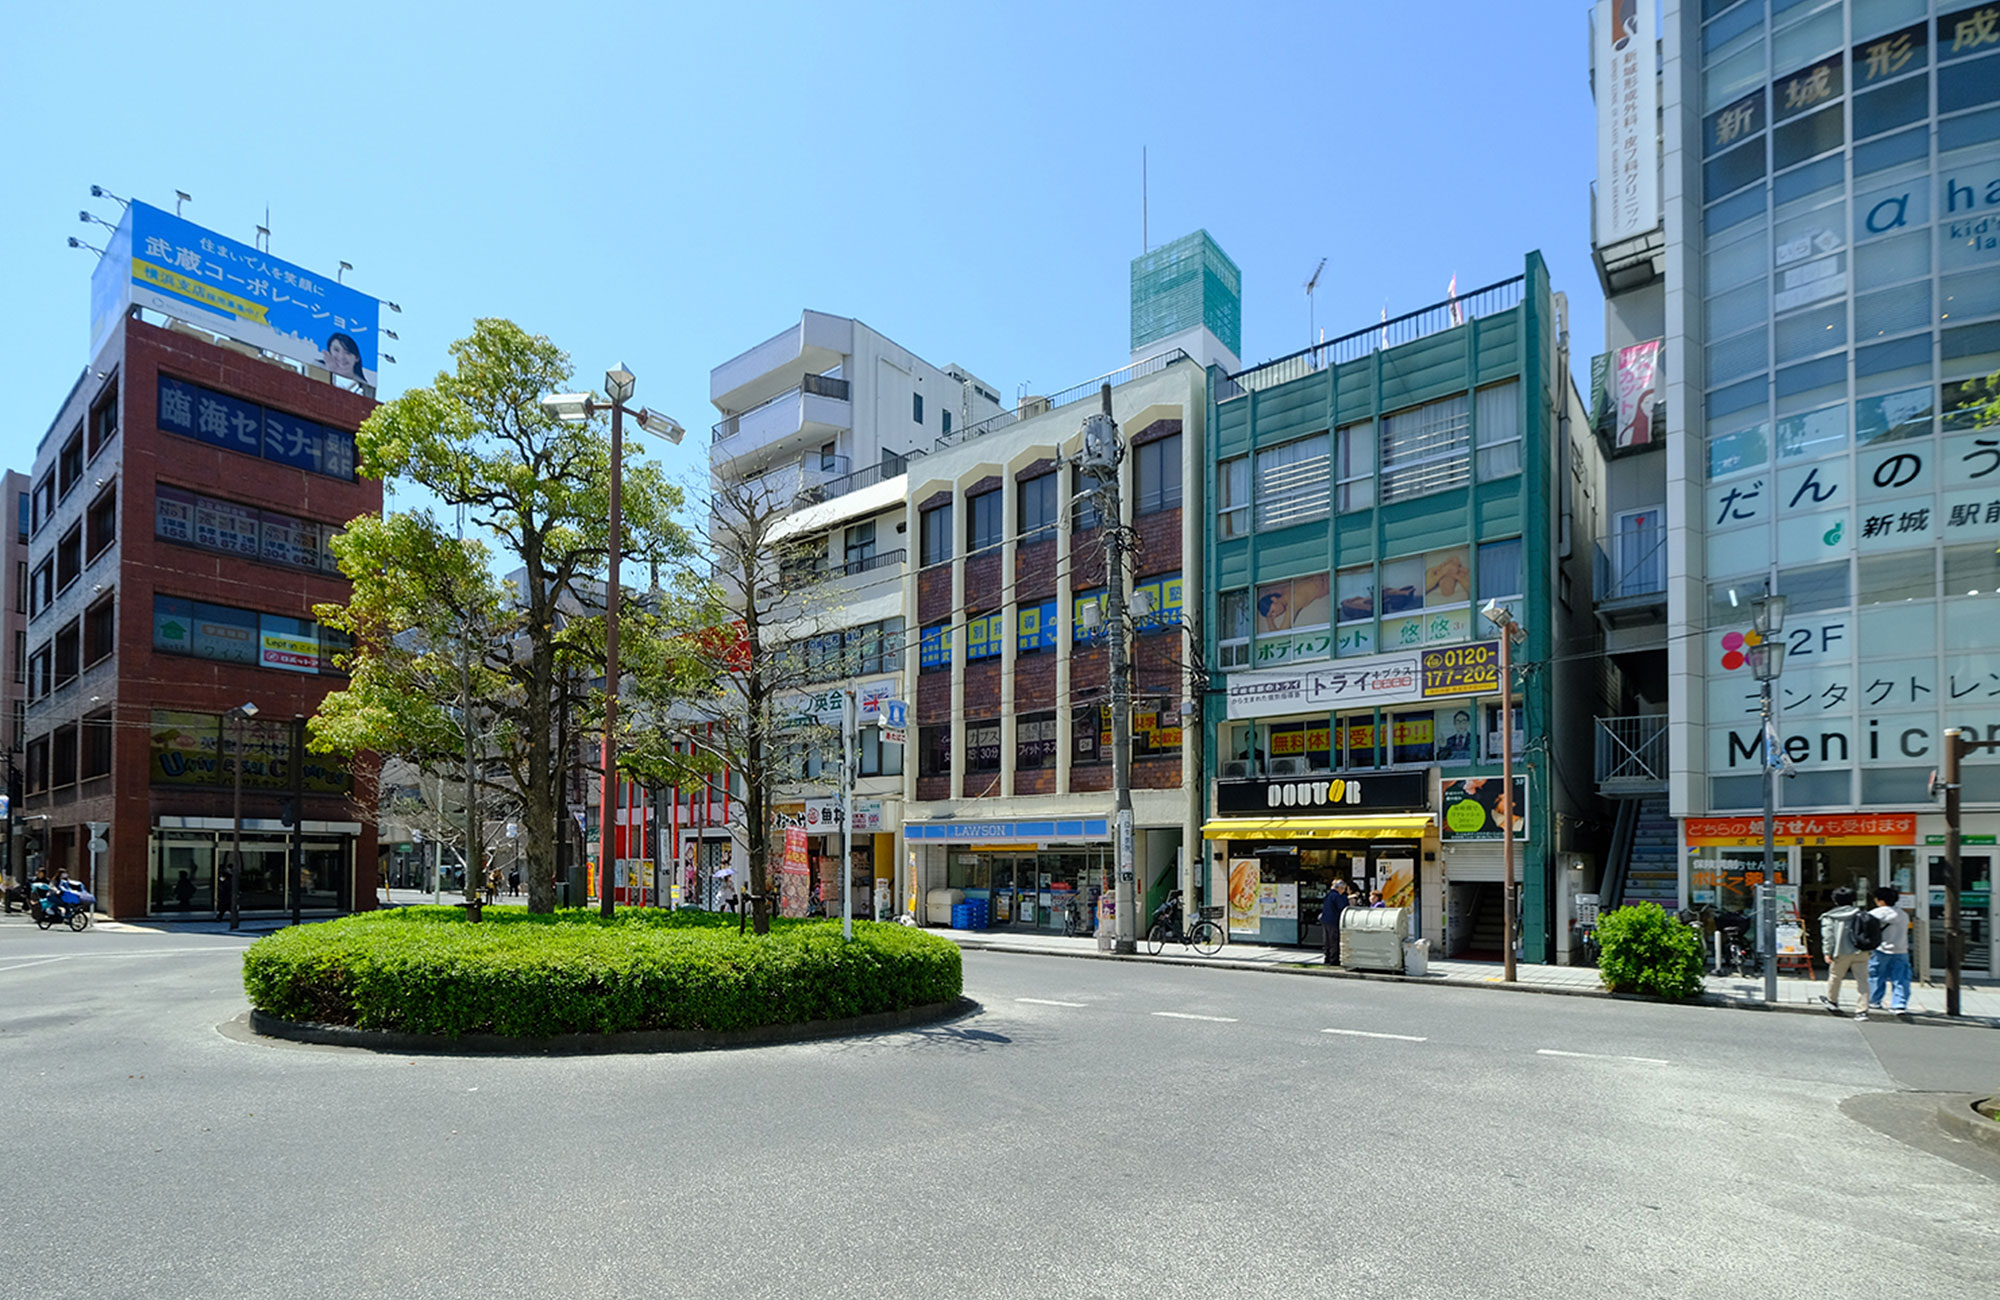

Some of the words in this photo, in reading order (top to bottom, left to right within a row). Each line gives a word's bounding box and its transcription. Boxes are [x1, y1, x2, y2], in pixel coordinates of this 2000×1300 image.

[144, 236, 368, 334] 武蔵コーポレーション
[1788, 624, 1845, 656] 2F
[1314, 672, 1370, 696] トライ
[1425, 664, 1497, 687] 177-202
[1267, 778, 1362, 808] DOUTOR
[954, 825, 1006, 838] LAWSON
